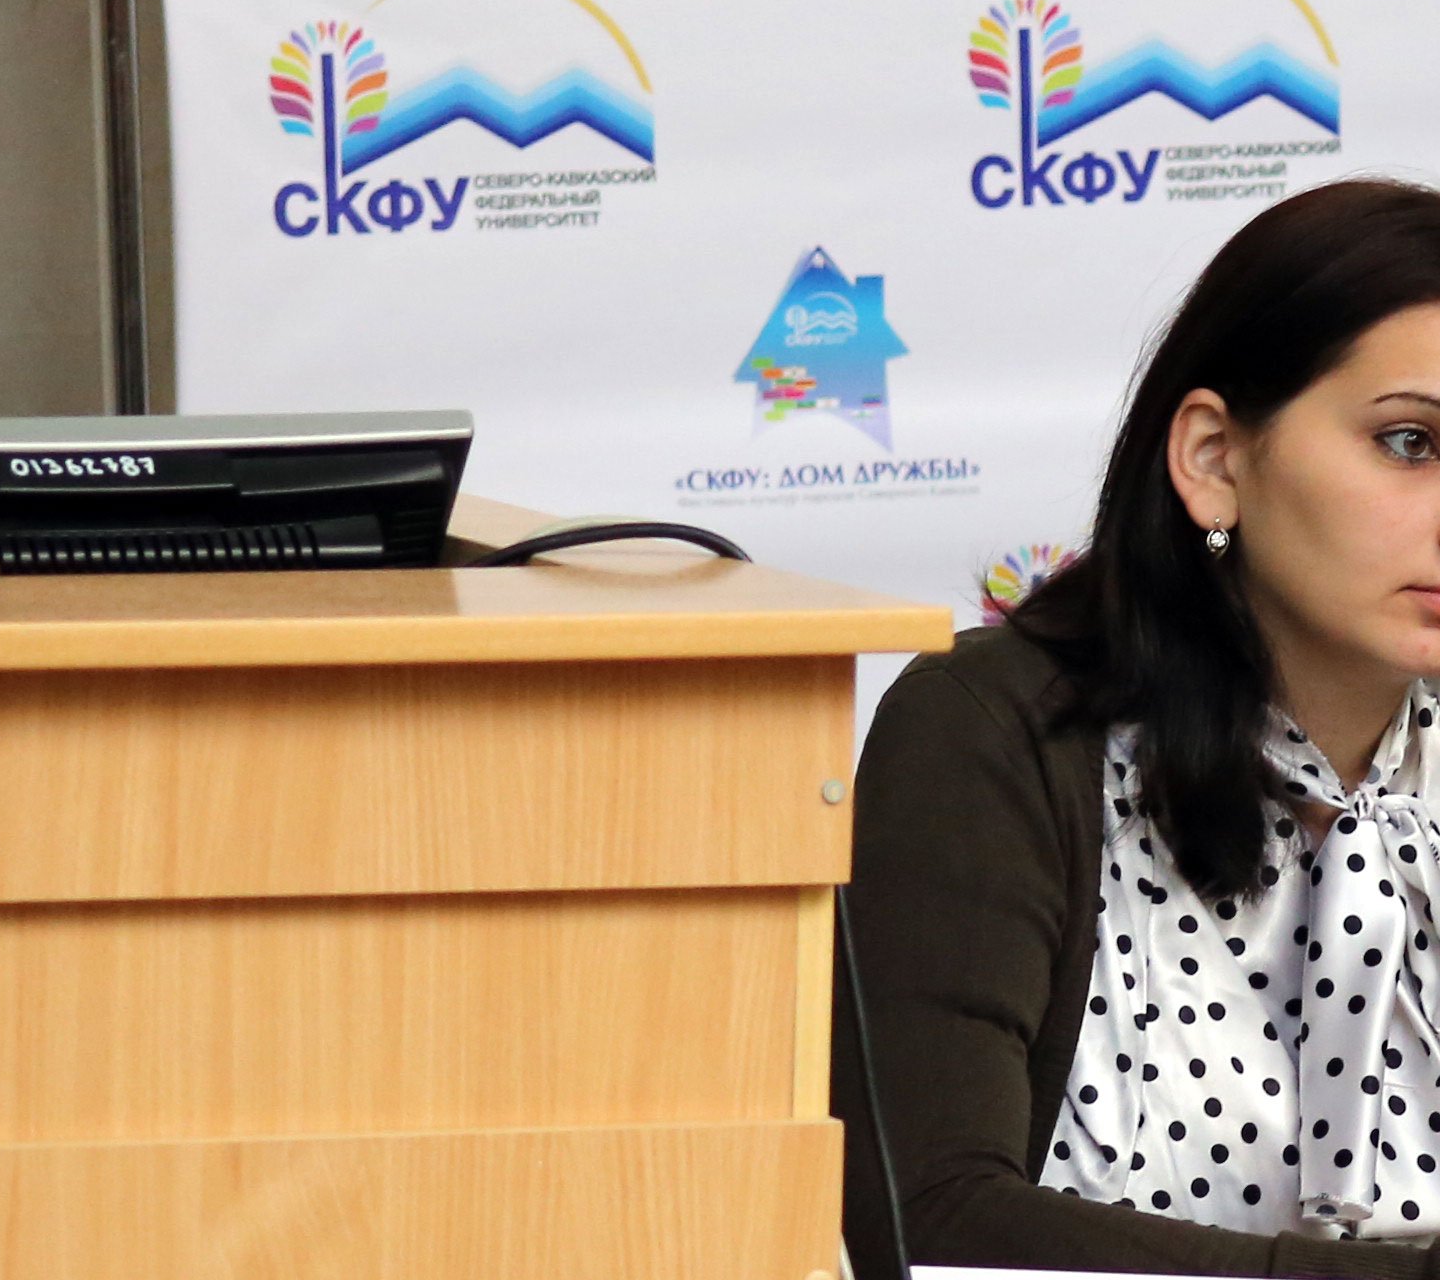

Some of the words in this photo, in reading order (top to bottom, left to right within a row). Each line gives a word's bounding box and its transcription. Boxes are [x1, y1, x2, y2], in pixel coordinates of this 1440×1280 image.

[969, 148, 1162, 211] СКФУ
[273, 176, 471, 240] СКФУ
[472, 187, 602, 211] ФЕДЕРАЛЬНЫЙ
[474, 207, 602, 231] УНИВЕРСИТЕТ
[778, 462, 845, 489] ДОМ
